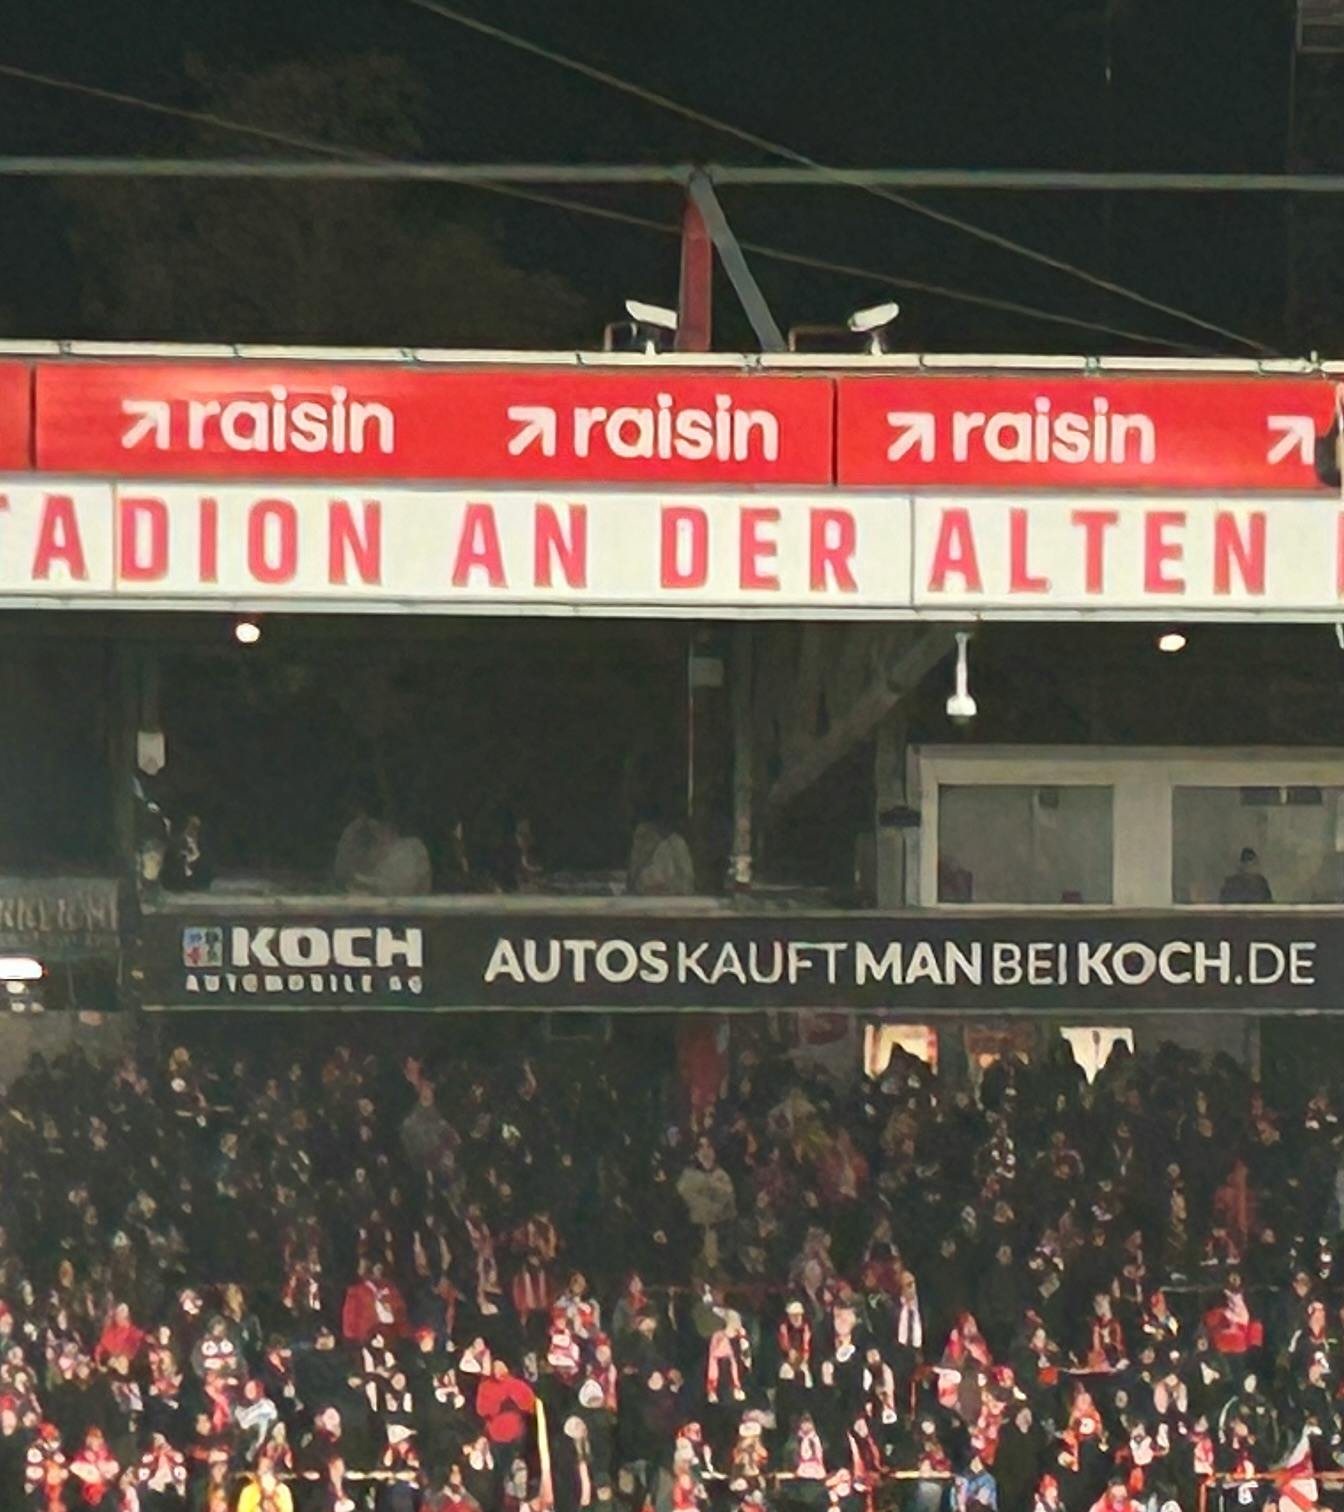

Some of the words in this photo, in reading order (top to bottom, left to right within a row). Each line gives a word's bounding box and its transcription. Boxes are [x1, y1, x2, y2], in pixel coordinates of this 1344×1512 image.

[188, 385, 395, 455] raisin
[574, 392, 778, 462] raisin
[953, 396, 1155, 465] raisin
[451, 502, 589, 590] AN
[659, 505, 859, 594] DER
[927, 506, 1268, 597] ALTEN
[230, 926, 424, 968] KOCH
